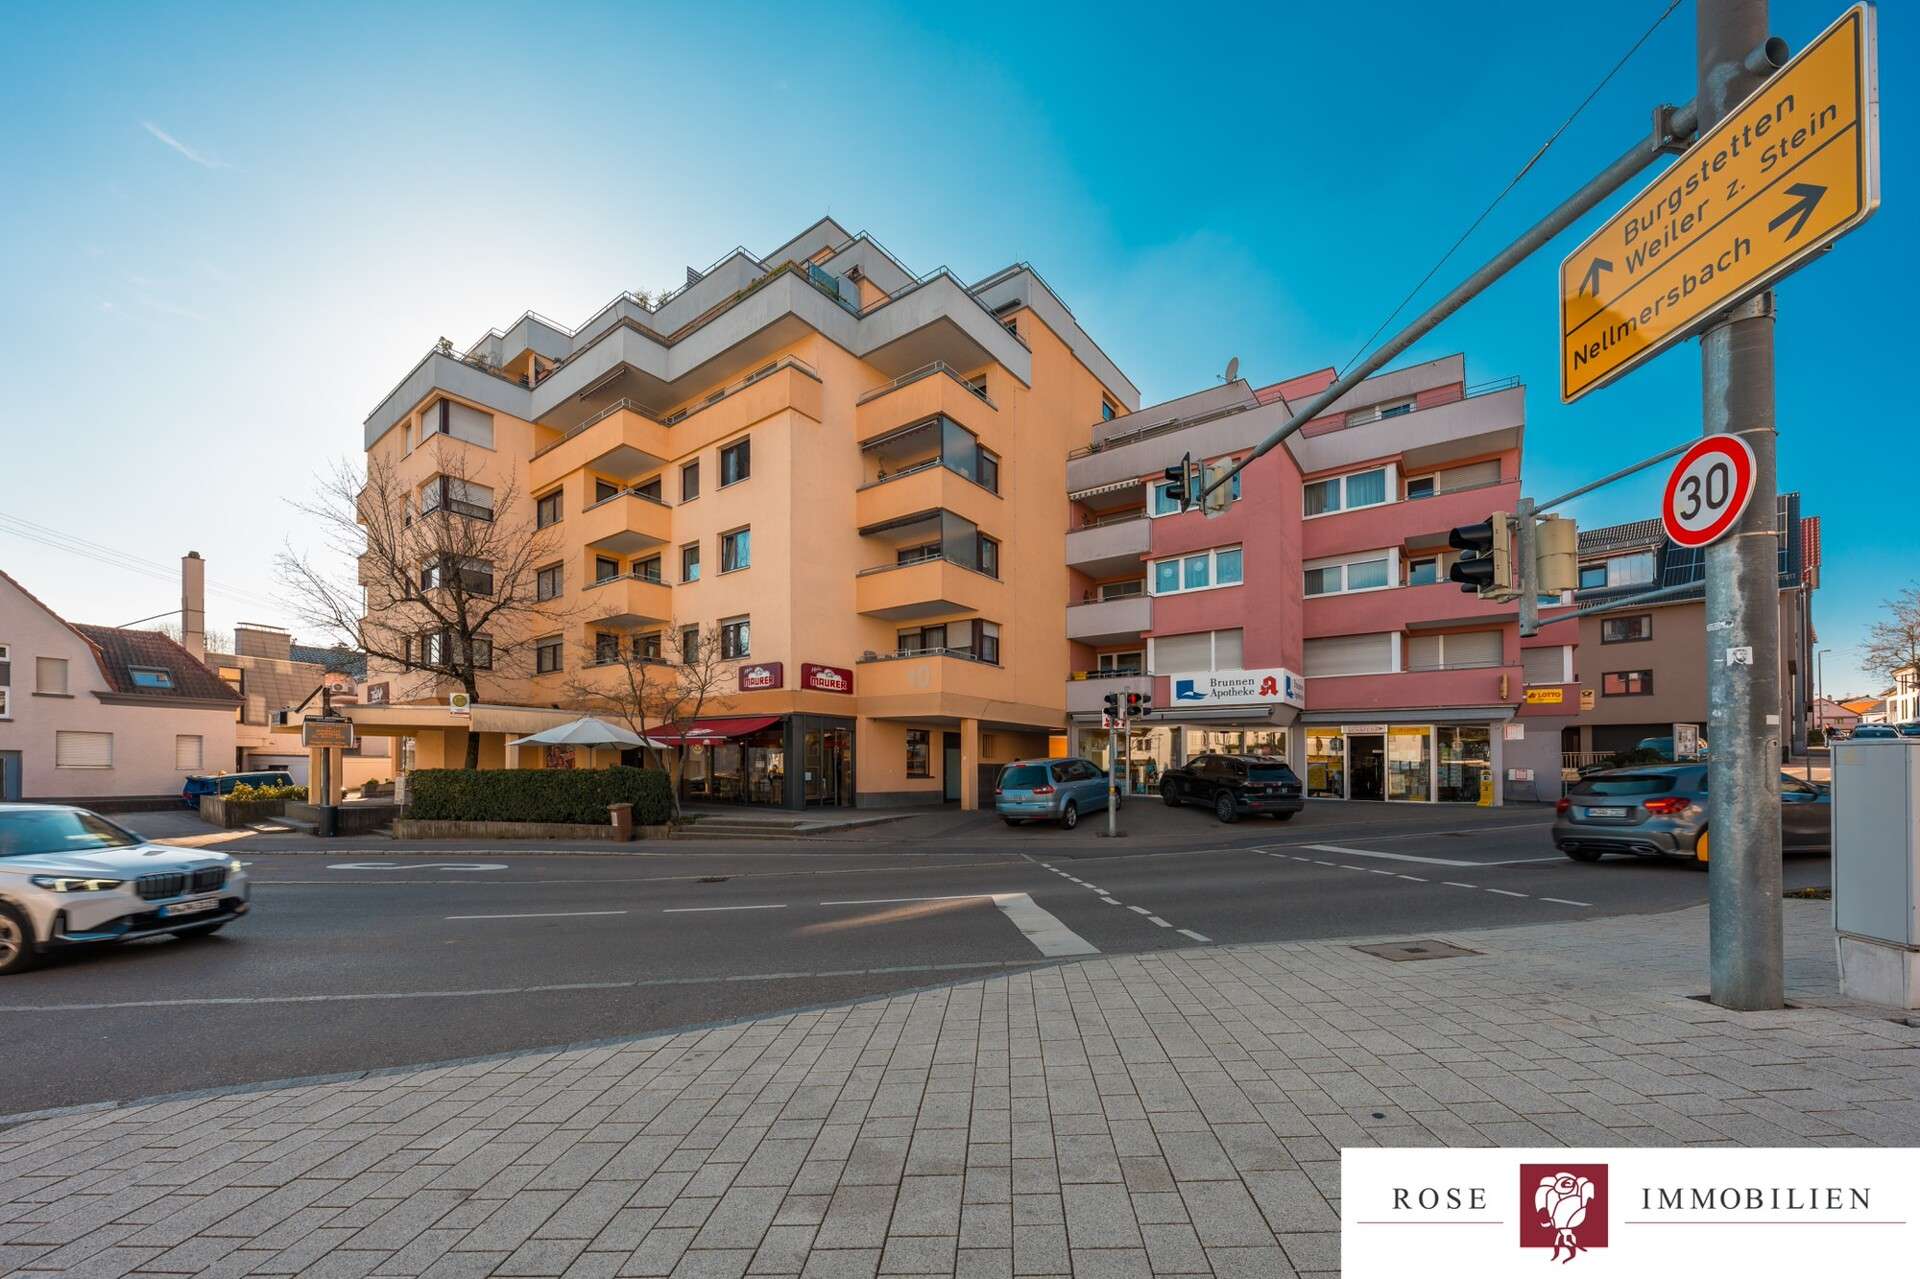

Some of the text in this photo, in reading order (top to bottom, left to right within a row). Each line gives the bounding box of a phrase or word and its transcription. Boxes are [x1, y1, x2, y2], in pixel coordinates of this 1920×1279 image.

[1624, 93, 1795, 246] Burgstetten
[1625, 104, 1838, 275] Weiler z. Stein
[1574, 238, 1751, 370] Nellmersbach
[1679, 462, 1729, 520] 30
[744, 675, 775, 687] MAURER
[810, 675, 848, 690] MAURER
[1210, 677, 1255, 688] Brunnen
[1210, 687, 1255, 699] Apotheke
